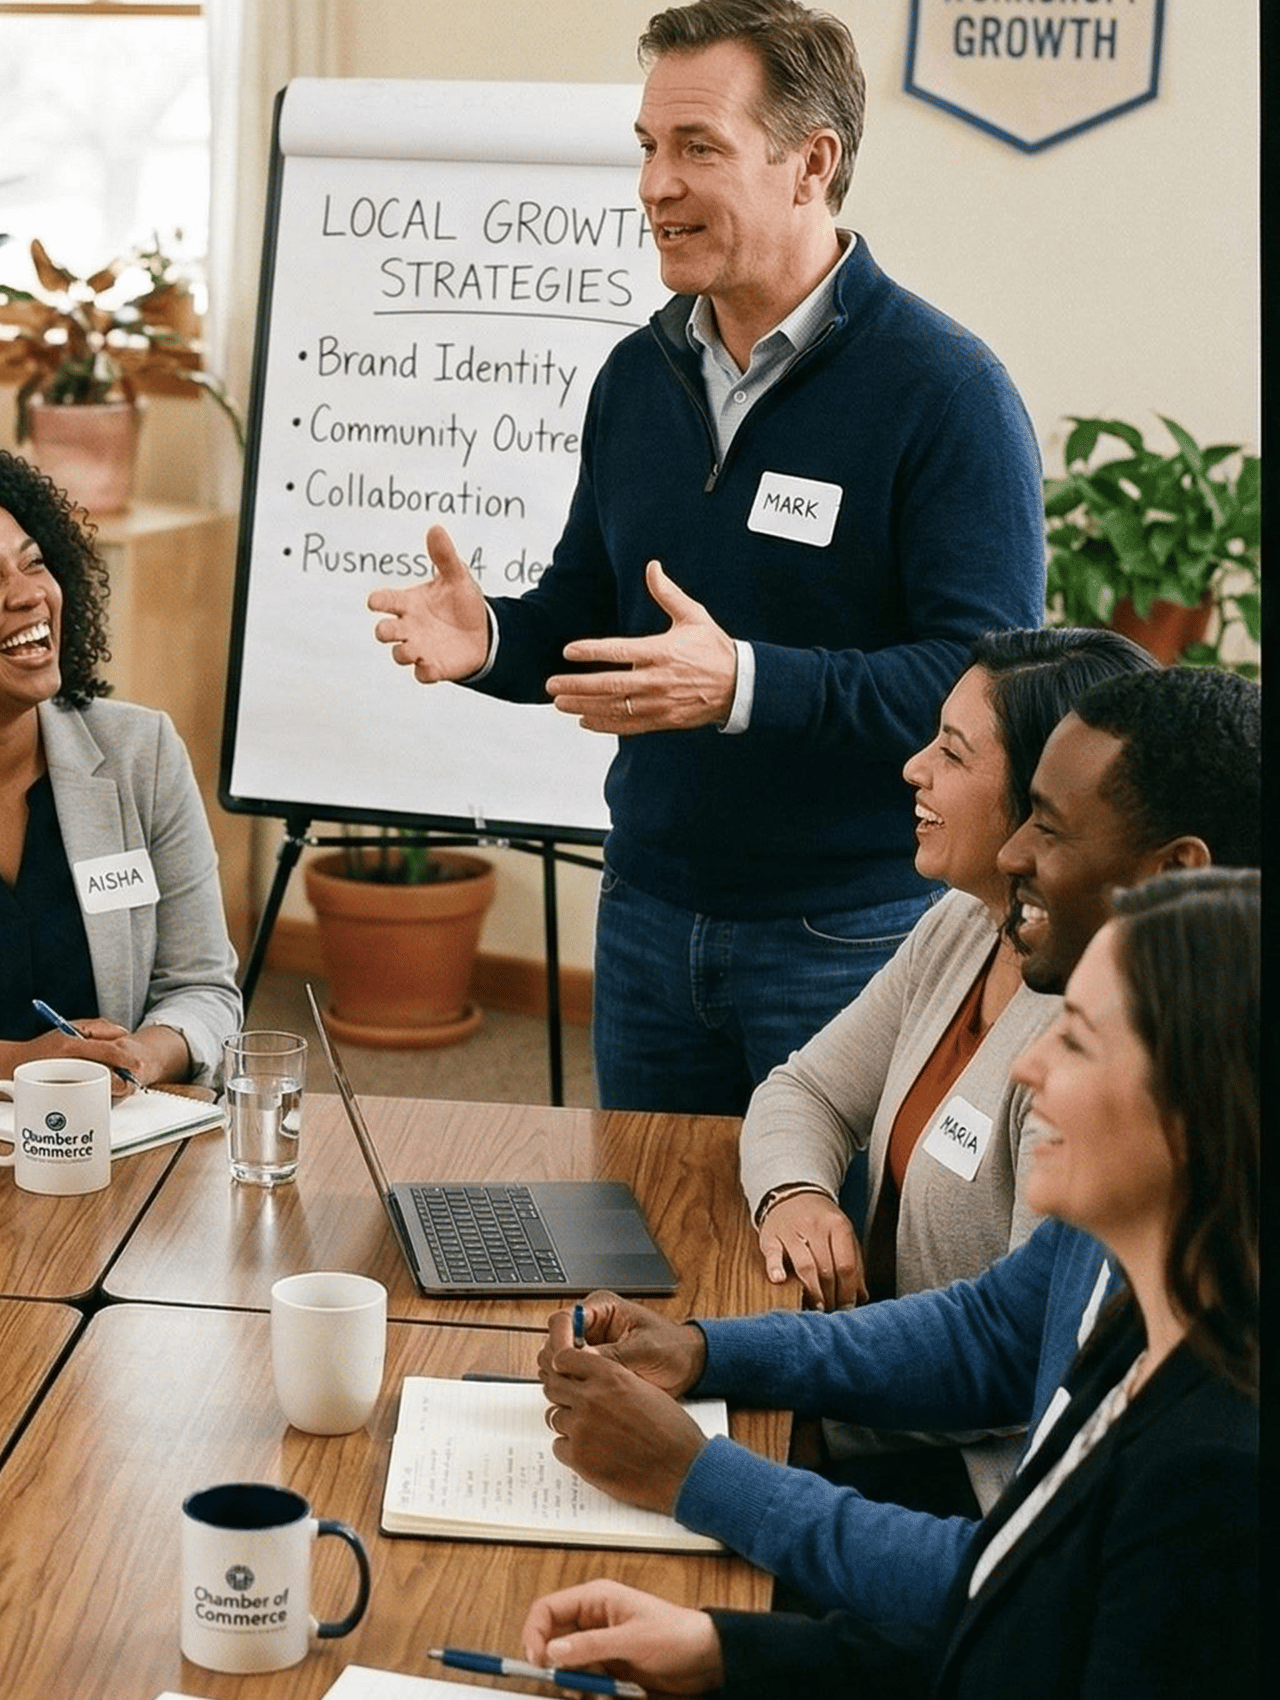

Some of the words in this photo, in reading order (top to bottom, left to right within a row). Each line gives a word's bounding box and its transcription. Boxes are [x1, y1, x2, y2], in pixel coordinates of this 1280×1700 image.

[953, 15, 1118, 60] GROWTH
[321, 194, 458, 241] LOCAL
[380, 257, 633, 307] STRATEGIES
[318, 335, 418, 379] Brand
[432, 342, 578, 409] Identity
[309, 403, 478, 468] Community
[492, 413, 579, 454] Outre
[305, 468, 526, 520] Collaboration
[763, 492, 820, 520] MARK
[302, 532, 435, 578] Rusness
[503, 547, 552, 584] de
[88, 867, 144, 894] AISHA
[22, 1140, 93, 1158] Commerce
[80, 1129, 95, 1144] of
[940, 1115, 978, 1155] MARIA
[195, 1602, 288, 1626] Commerce
[272, 1588, 289, 1606] of
